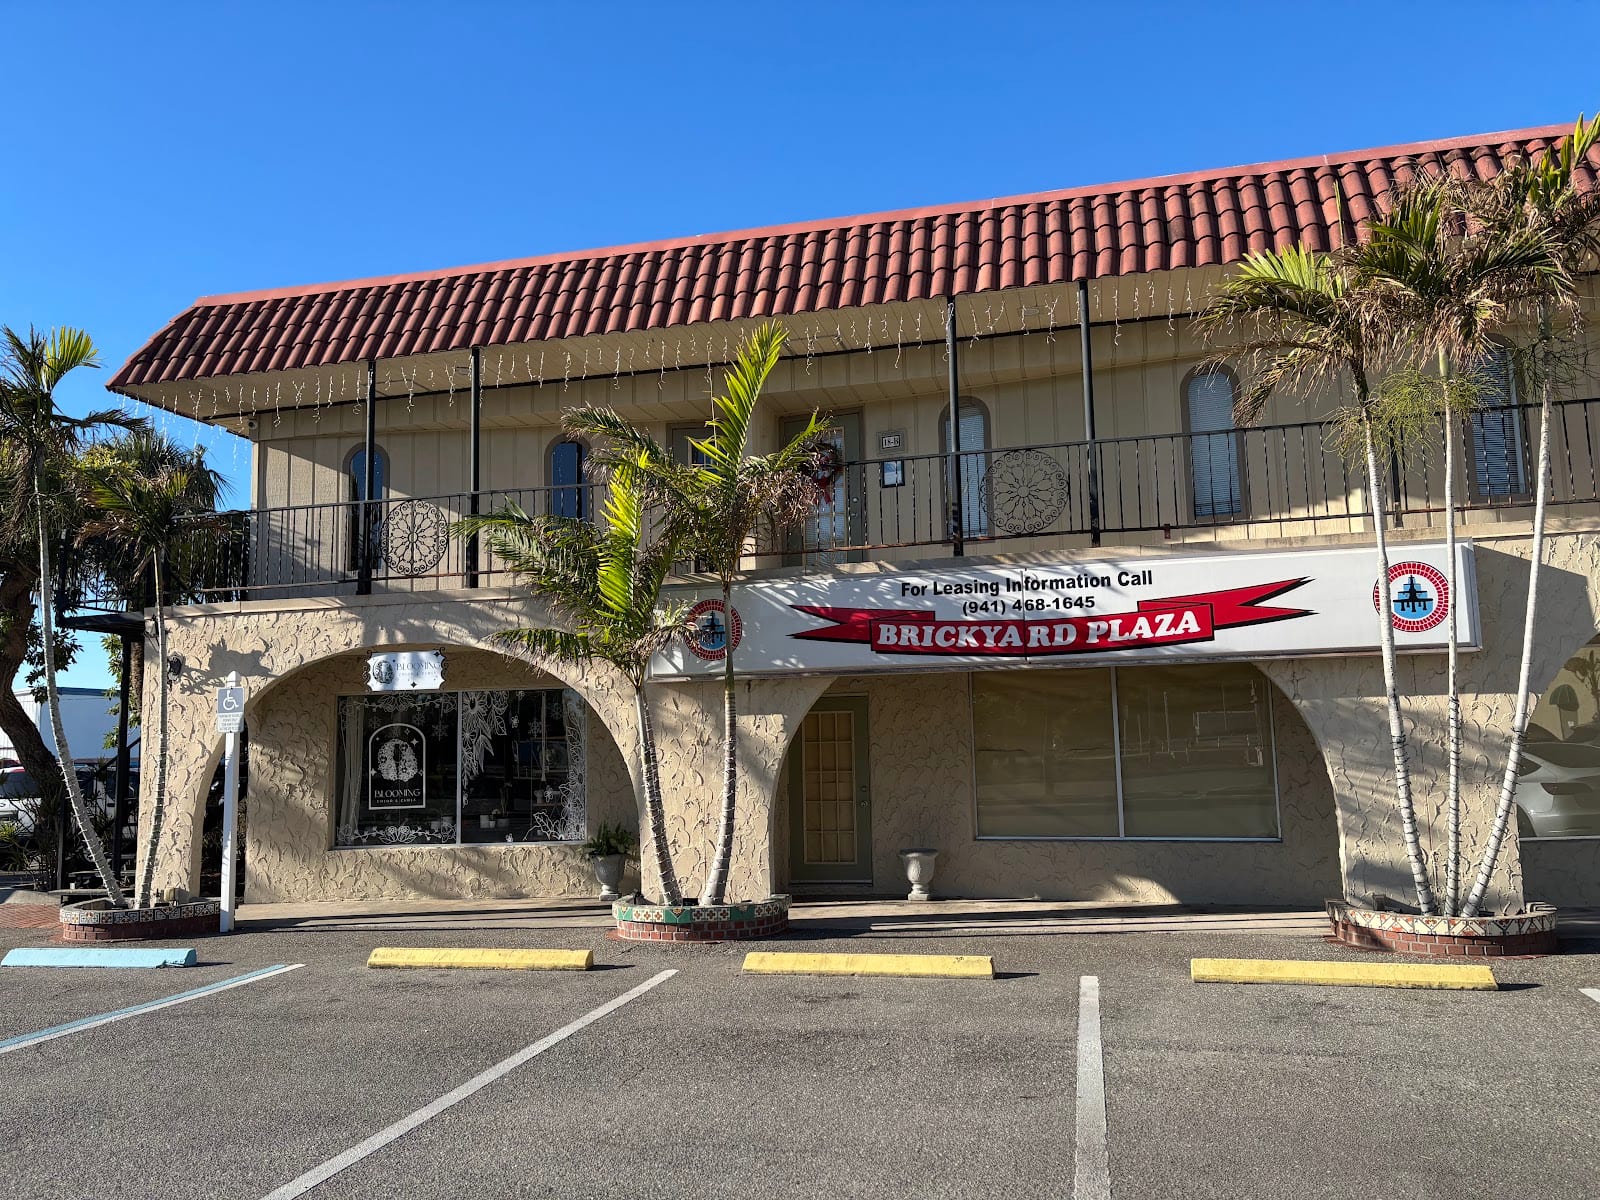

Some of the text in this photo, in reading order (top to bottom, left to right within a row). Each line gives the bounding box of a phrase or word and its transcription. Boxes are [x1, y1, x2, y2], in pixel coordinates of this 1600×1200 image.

[901, 570, 1153, 597] For Leasing Information Call
[962, 596, 1095, 616] (941) 468-1645
[877, 610, 1201, 648] BRICKYARD PLAZA
[374, 788, 421, 798] BLOOMING
